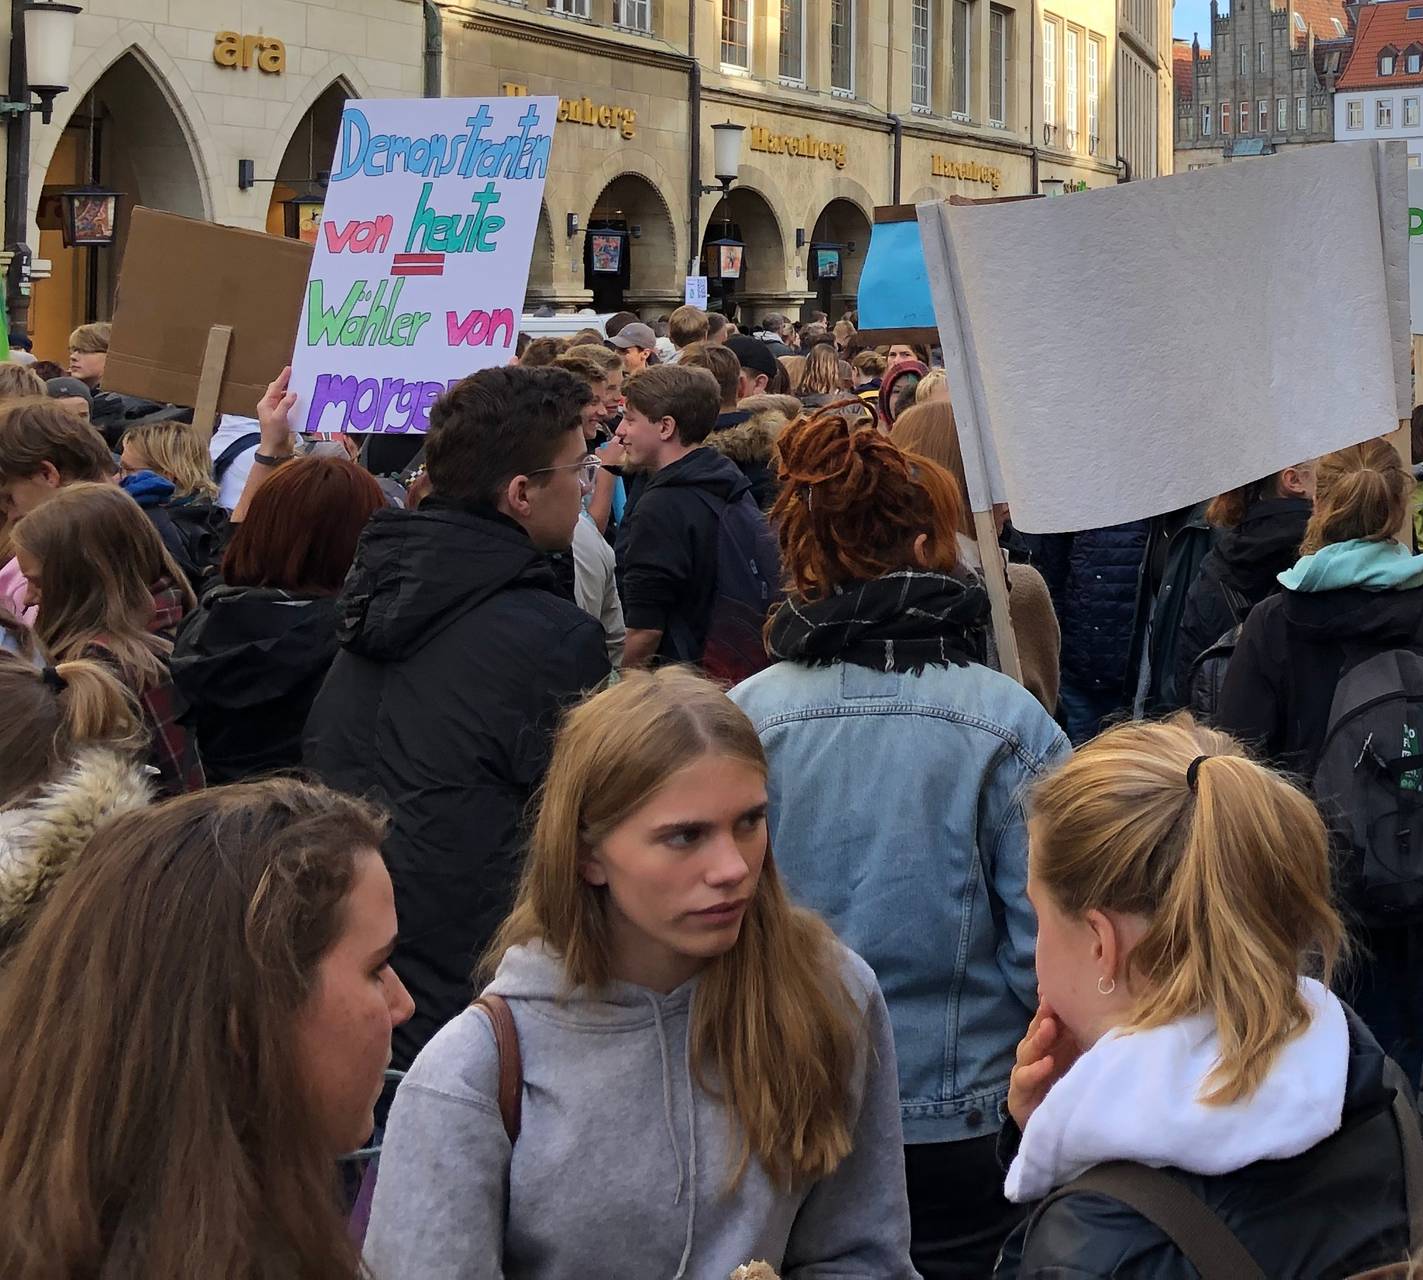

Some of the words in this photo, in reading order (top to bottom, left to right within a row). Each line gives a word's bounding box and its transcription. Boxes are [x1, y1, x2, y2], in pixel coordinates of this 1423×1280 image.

[213, 31, 286, 74] ara
[331, 104, 551, 182] Demonstranten
[750, 126, 847, 169] Harenberg
[931, 154, 1001, 191] Harenberg
[324, 214, 394, 253] von
[405, 182, 505, 253] heute
[307, 276, 432, 347] Wähler
[446, 308, 514, 348] von
[305, 374, 460, 433] morge
